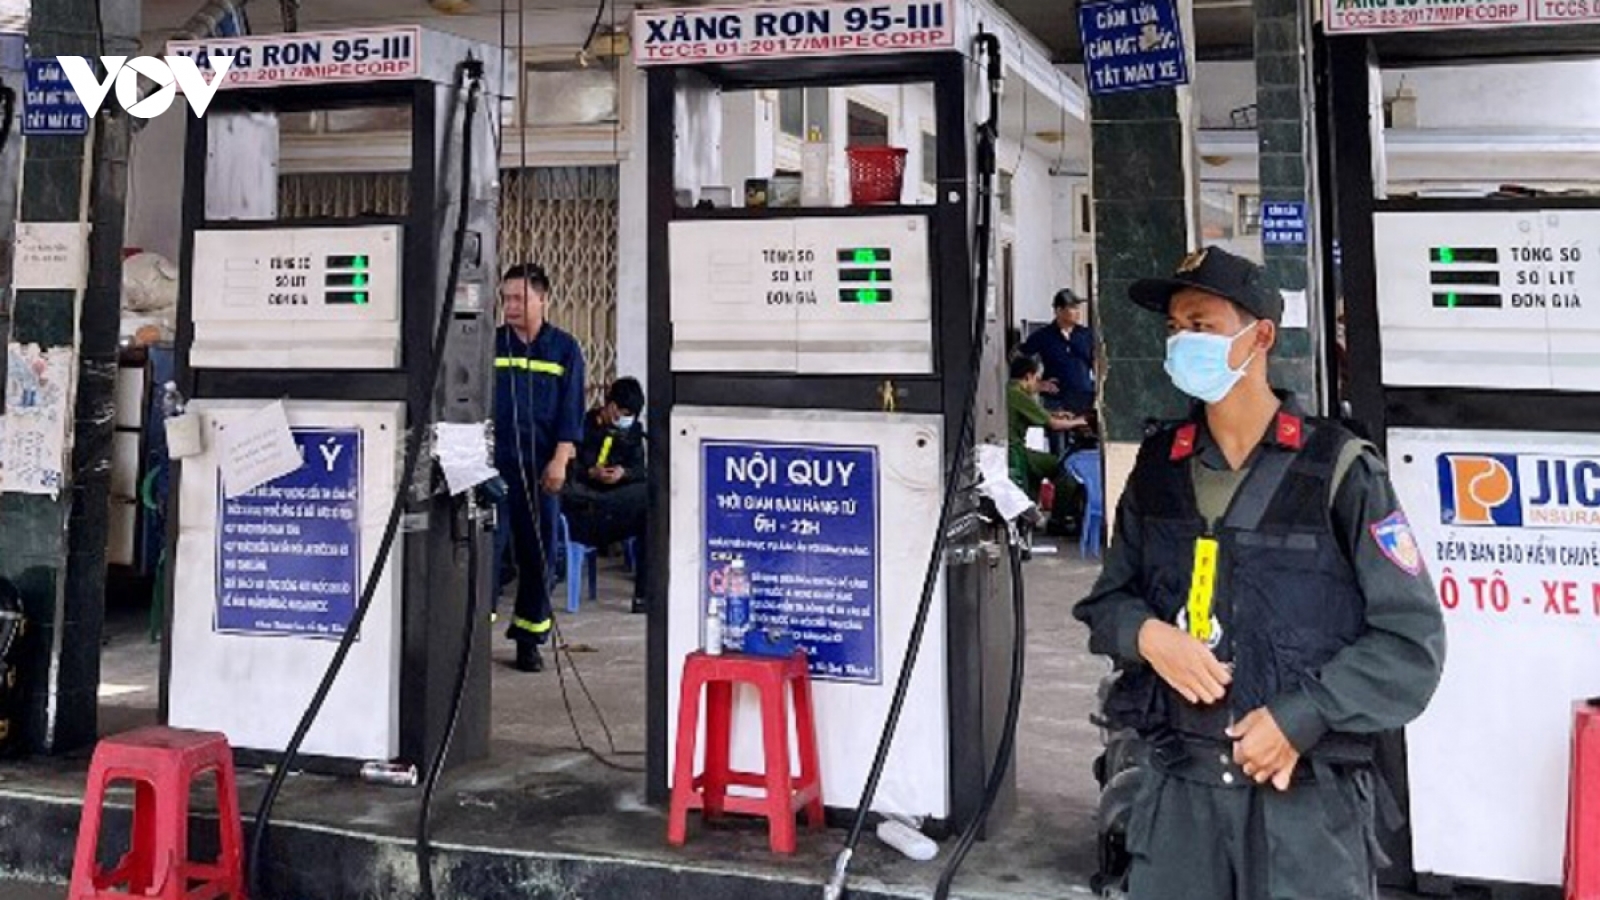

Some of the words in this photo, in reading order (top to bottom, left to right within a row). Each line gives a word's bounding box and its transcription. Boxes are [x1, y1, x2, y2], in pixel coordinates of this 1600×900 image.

[645, 12, 741, 43] XĂNG
[755, 9, 829, 36] RON
[843, 3, 943, 32] 95-III
[263, 42, 321, 66] RON
[332, 35, 410, 62] 95-III
[644, 42, 708, 57] TCCS
[319, 436, 343, 471] Ý
[726, 452, 777, 488] NỘI
[787, 459, 855, 486] QUY
[1529, 459, 1600, 507] JIC
[1440, 566, 1460, 609] Ô
[1468, 569, 1510, 612] TÔ
[1541, 580, 1580, 614] XE
